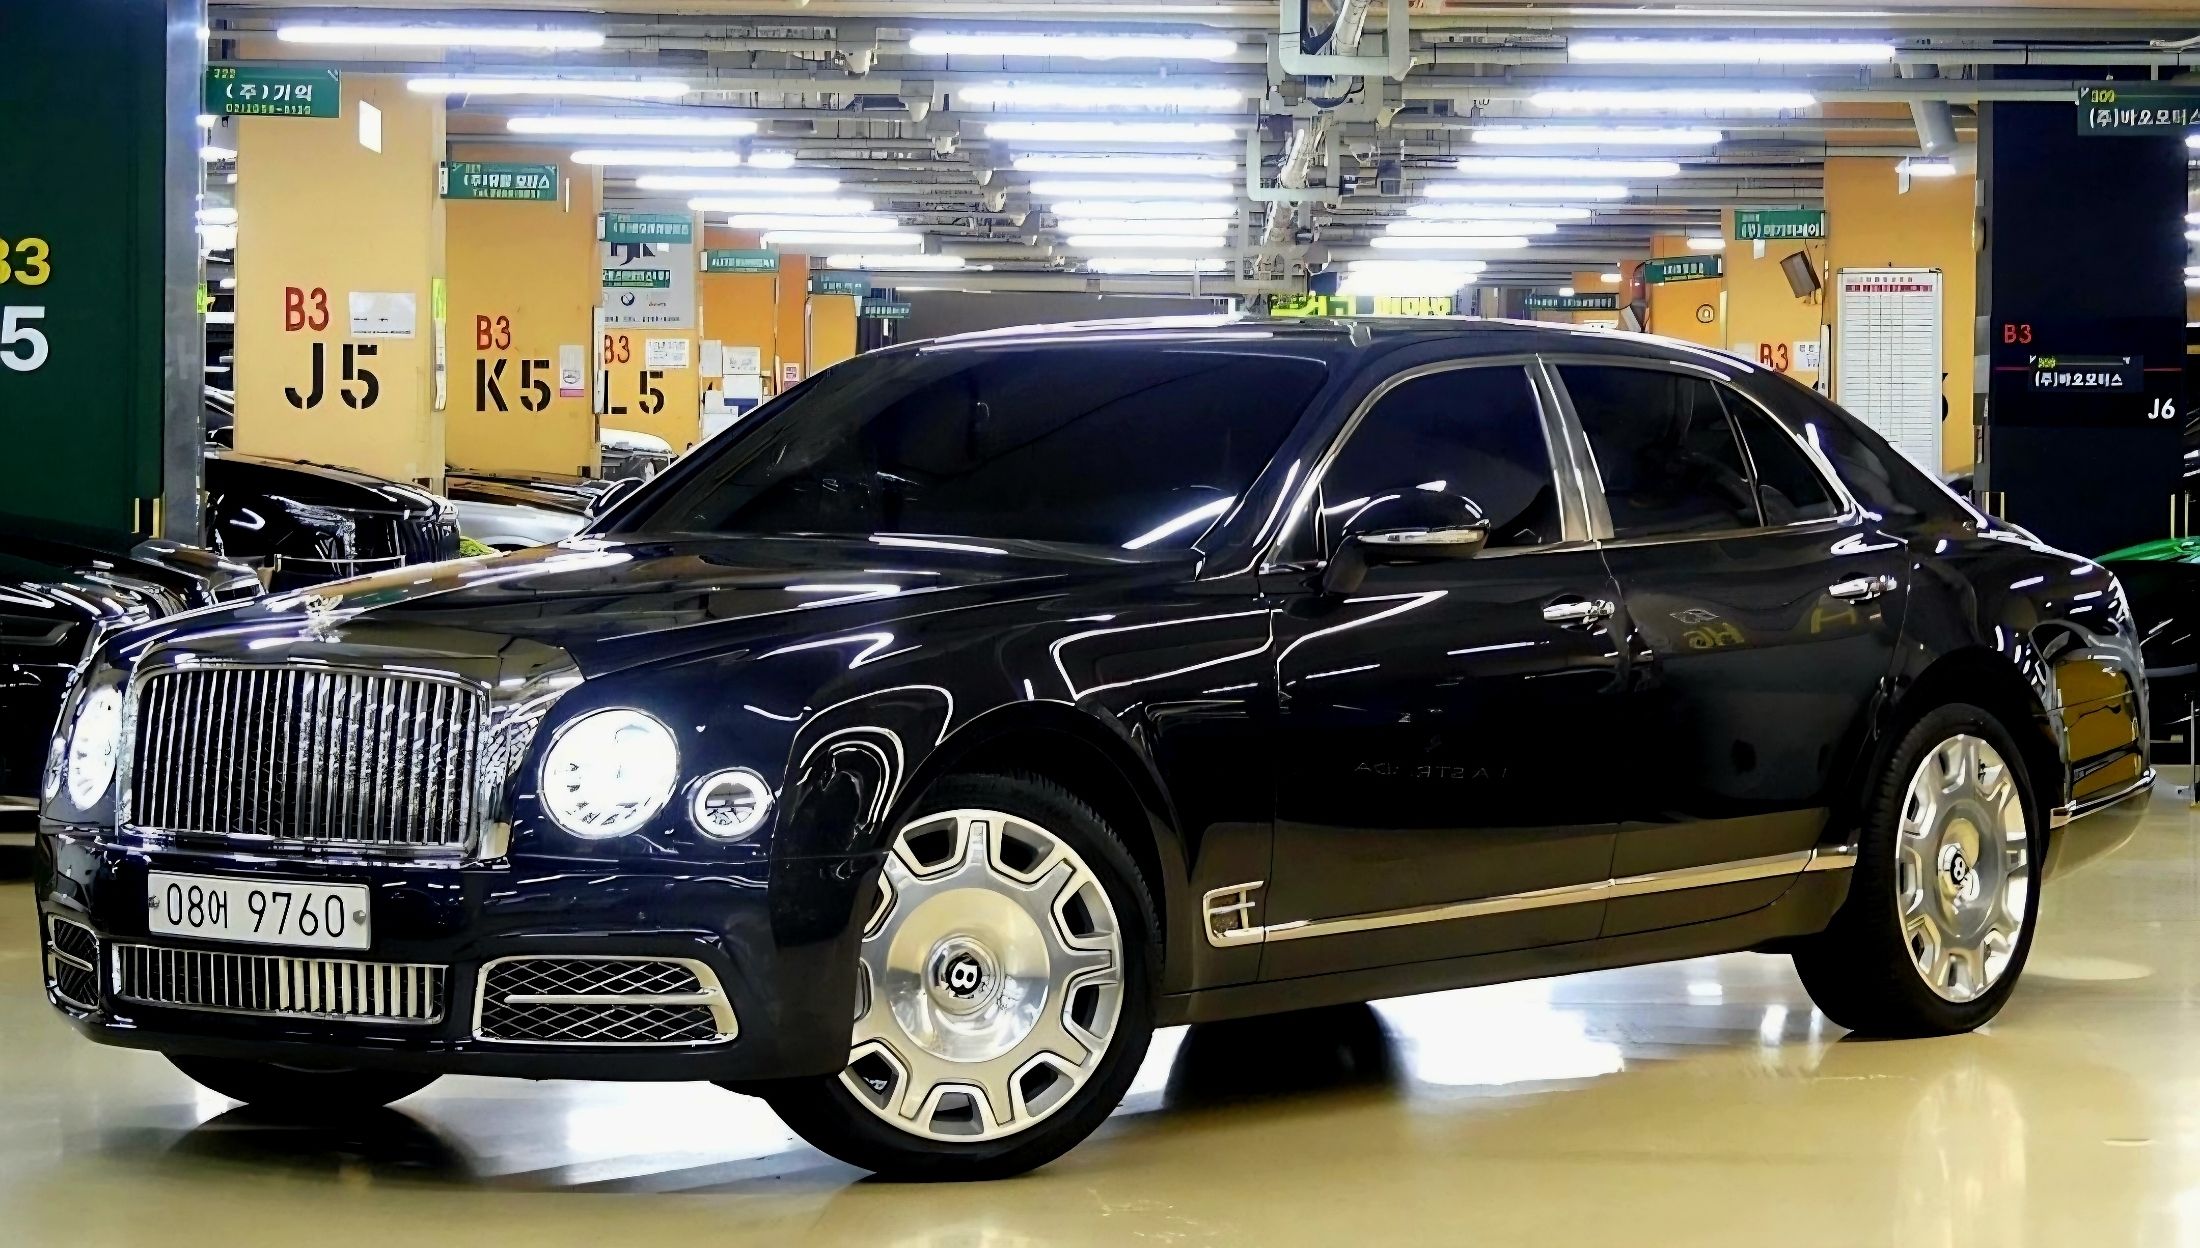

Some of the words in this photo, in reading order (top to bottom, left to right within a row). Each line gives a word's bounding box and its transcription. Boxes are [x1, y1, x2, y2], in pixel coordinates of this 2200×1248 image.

[285, 286, 329, 332] B3
[476, 314, 511, 350] B3
[2004, 324, 2032, 344] B3
[2147, 398, 2176, 420] J6
[167, 882, 228, 929] 08어
[248, 889, 345, 938] 9760
